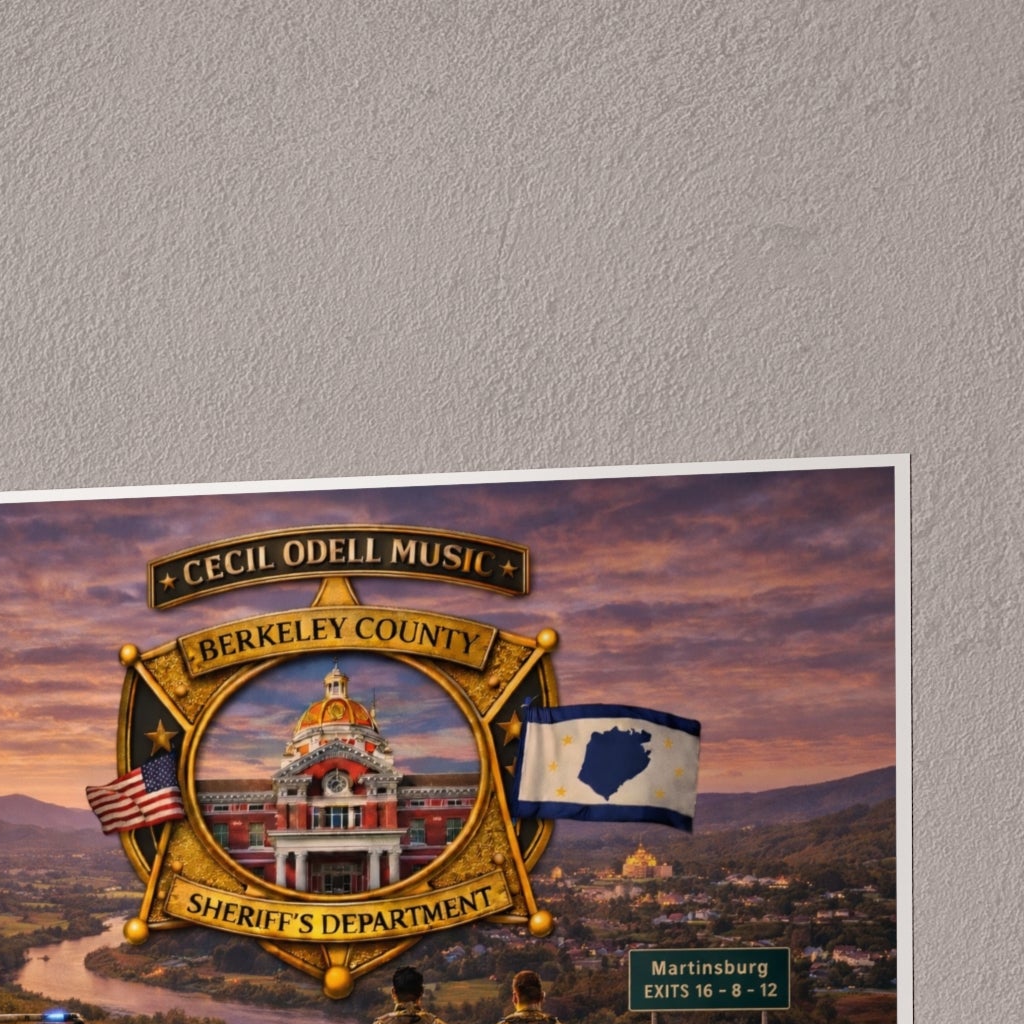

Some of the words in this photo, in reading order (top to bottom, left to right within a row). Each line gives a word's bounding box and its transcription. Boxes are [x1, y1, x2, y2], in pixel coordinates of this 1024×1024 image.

[183, 542, 275, 586] CECIL
[283, 537, 381, 566] ODELL
[391, 538, 497, 577] MUSIC
[199, 616, 348, 662] BERKELEY
[356, 616, 480, 654] COUNTY
[187, 893, 314, 935] SHERIFF'S
[322, 886, 492, 935] DEPARTMENT
[644, 984, 689, 999] EXITS
[695, 984, 713, 998] 16
[731, 983, 742, 998] 8
[760, 982, 778, 997] 12
[651, 960, 769, 979] Martinsburg
